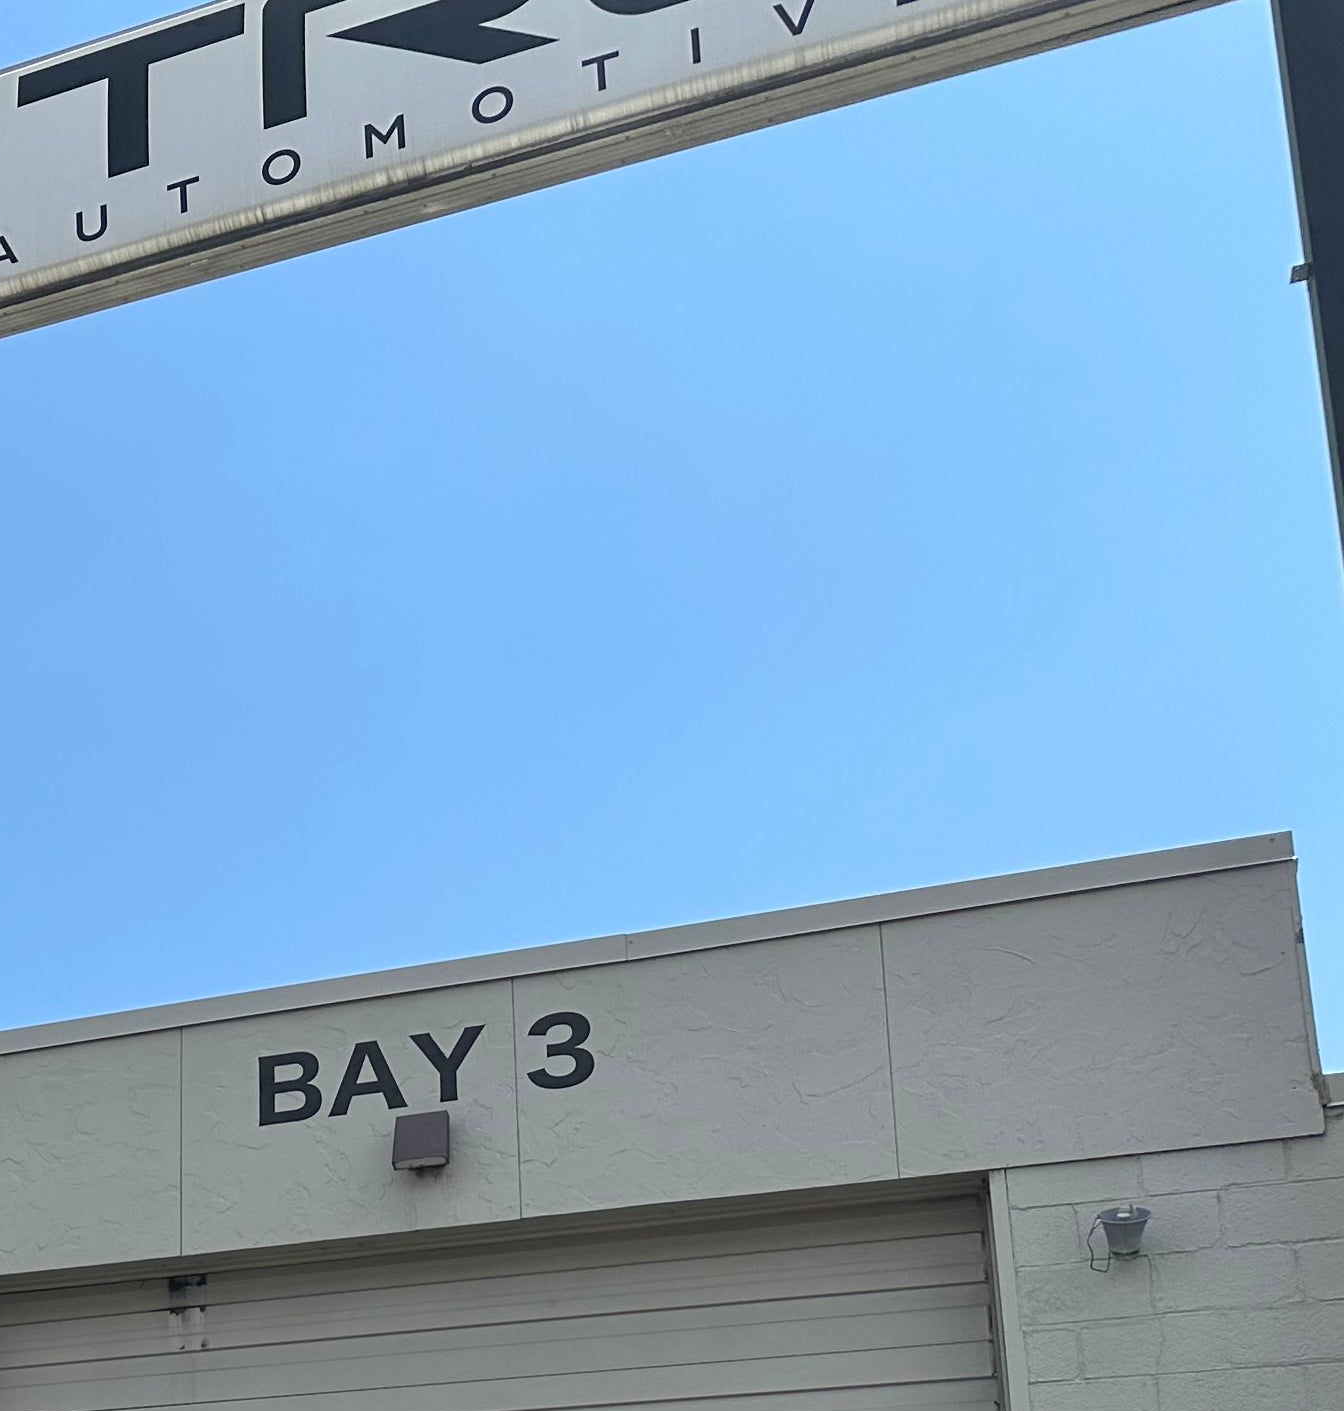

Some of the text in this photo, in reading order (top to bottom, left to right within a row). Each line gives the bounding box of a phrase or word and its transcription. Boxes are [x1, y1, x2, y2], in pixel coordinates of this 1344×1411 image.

[17, 0, 708, 178] TR
[258, 1011, 596, 1127] BAY 3
